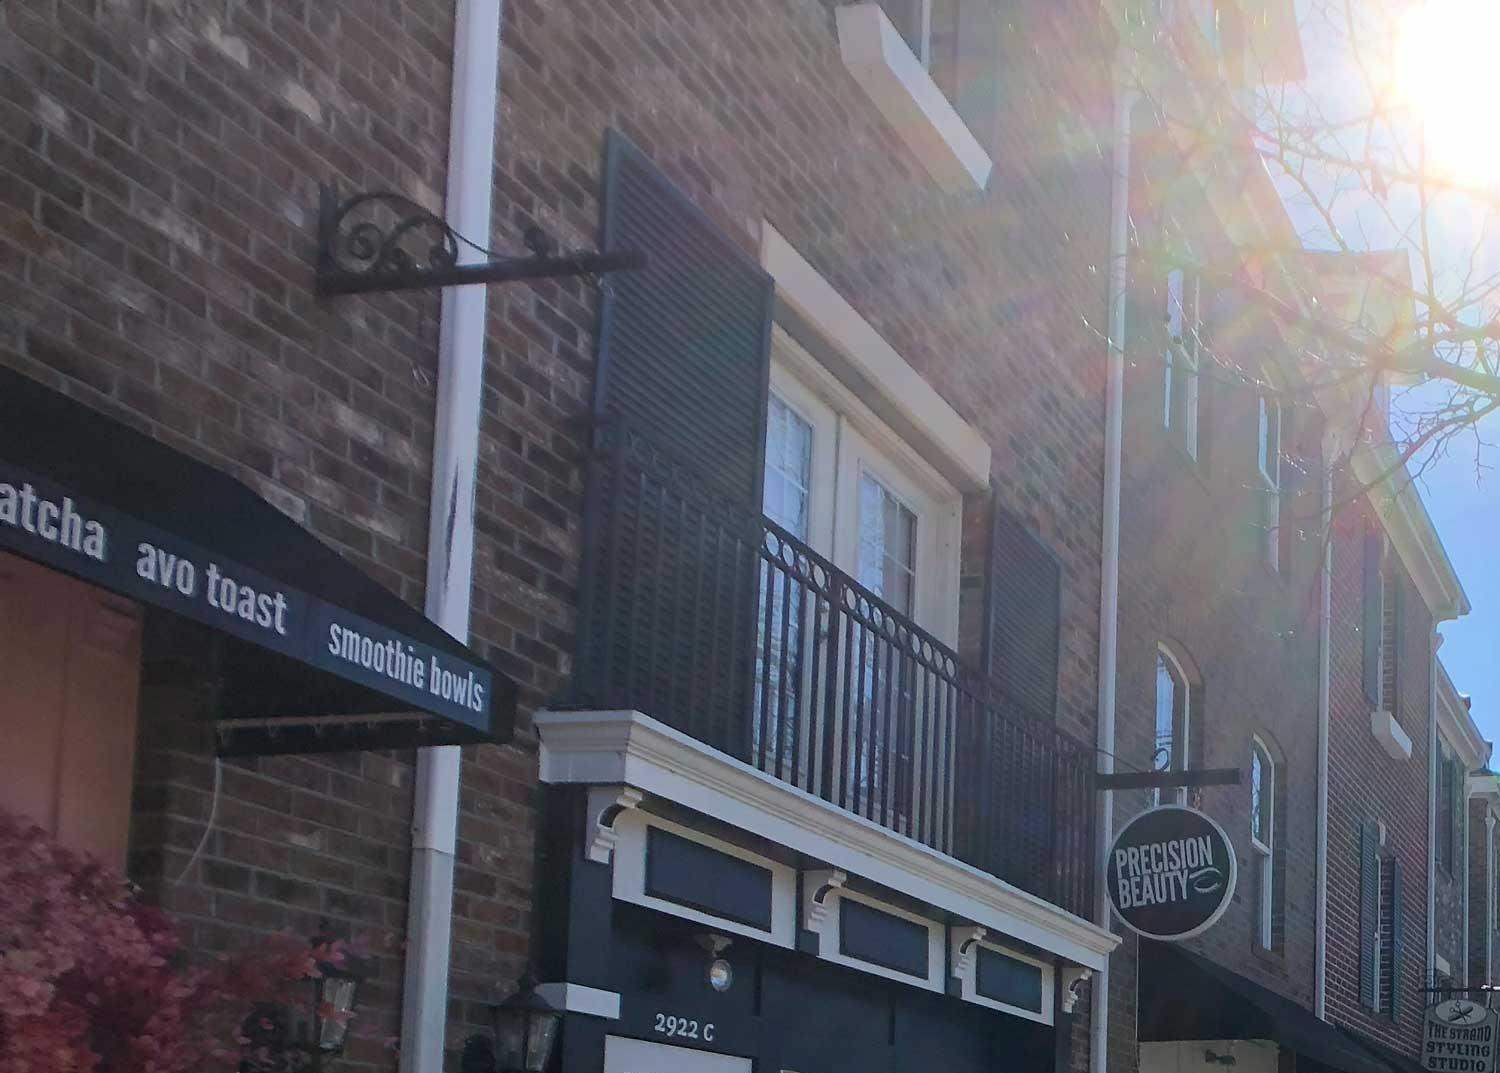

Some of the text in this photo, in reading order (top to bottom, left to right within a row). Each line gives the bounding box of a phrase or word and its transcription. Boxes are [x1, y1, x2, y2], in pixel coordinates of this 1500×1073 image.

[136, 541, 287, 635] avo toast
[328, 622, 484, 713] smoothie bowls
[1115, 835, 1213, 879] PRECISION
[1119, 868, 1189, 909] BEAUTY
[654, 1013, 715, 1042] 2922 C
[1428, 1021, 1491, 1042] THE STRAND
[1426, 1041, 1490, 1057] STYLING
[1428, 1056, 1486, 1072] STUDIO
